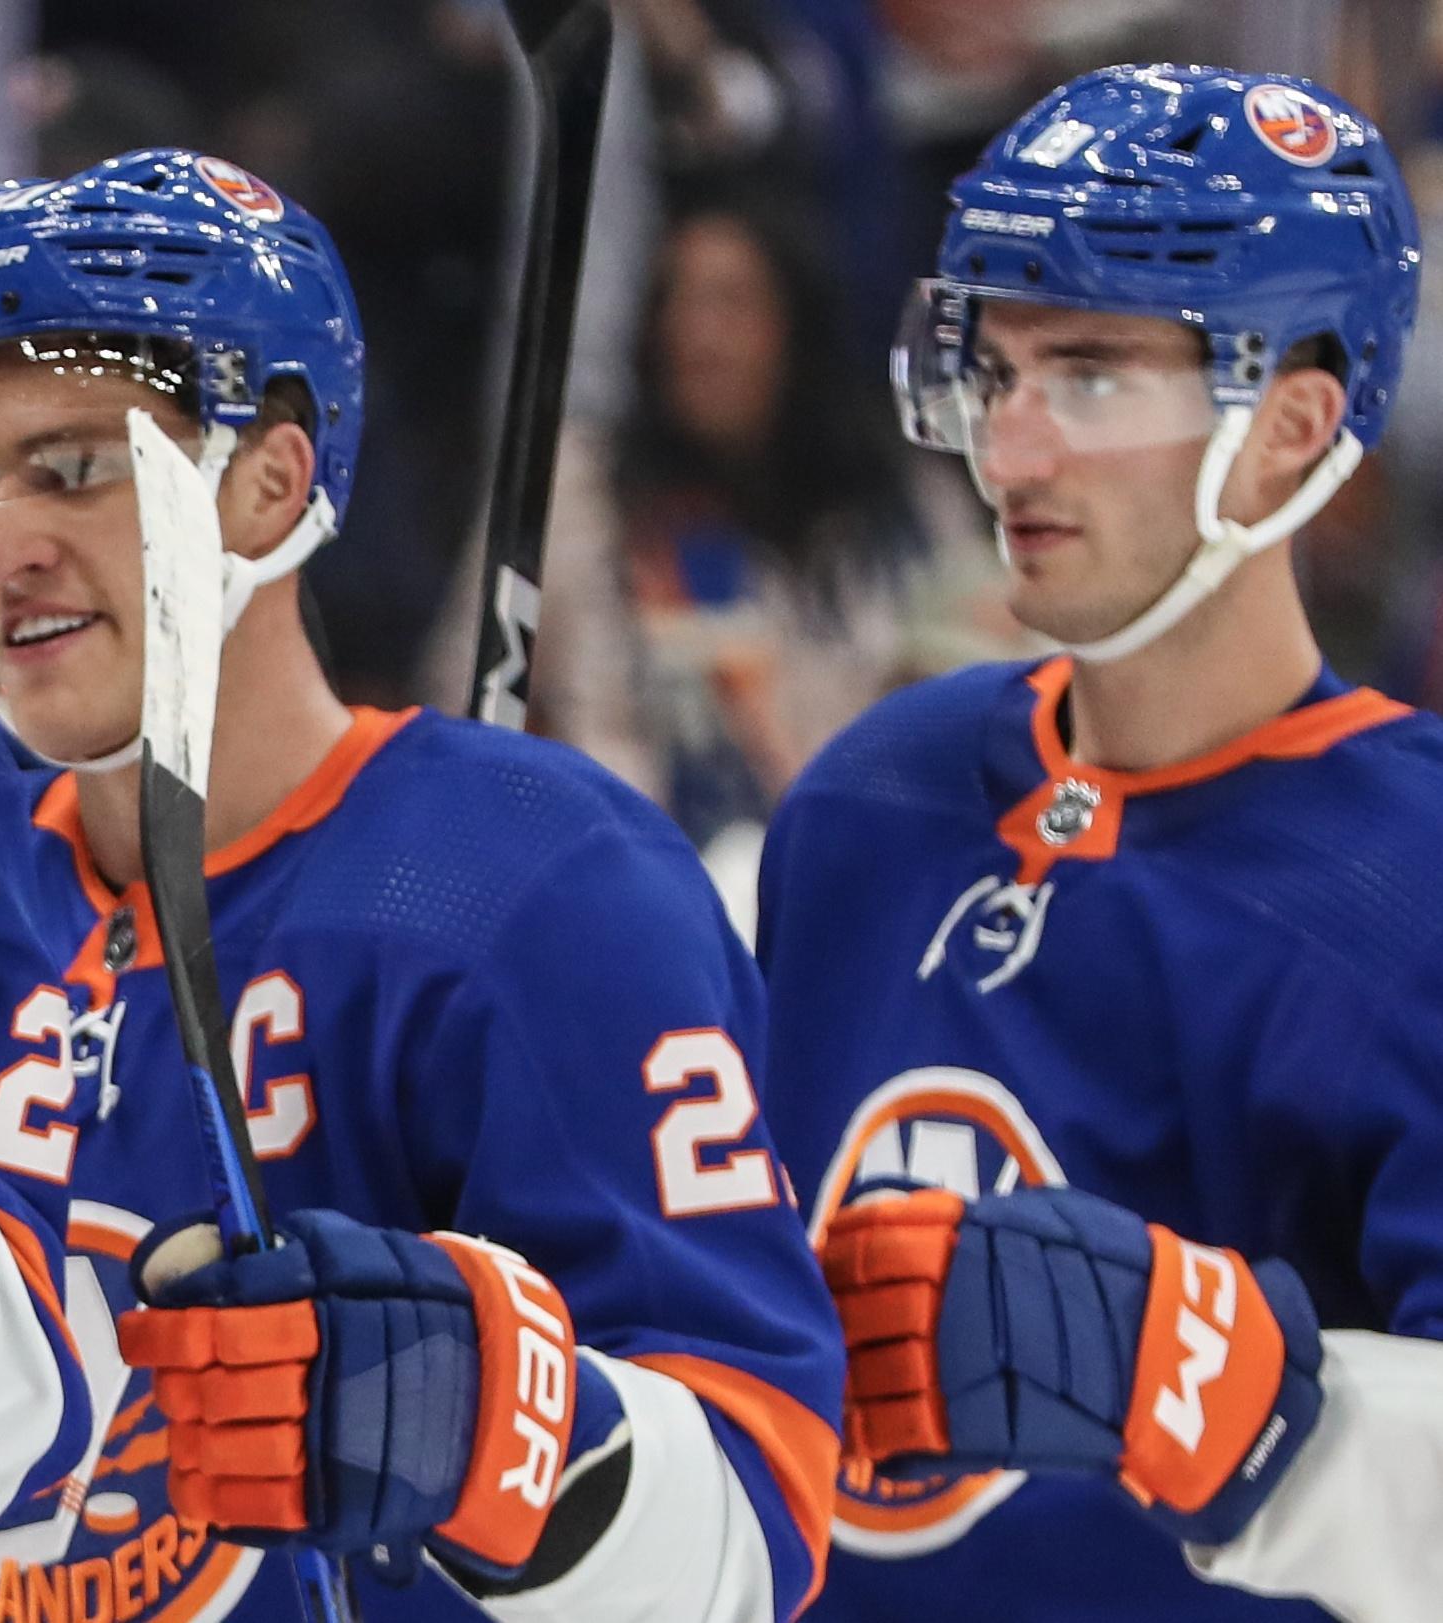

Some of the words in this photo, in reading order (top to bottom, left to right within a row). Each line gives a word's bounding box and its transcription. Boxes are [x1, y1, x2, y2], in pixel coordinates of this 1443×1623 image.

[229, 968, 318, 1162] C
[640, 1025, 799, 1221] 2
[491, 1250, 568, 1510] UER
[1153, 1238, 1238, 1456] CM
